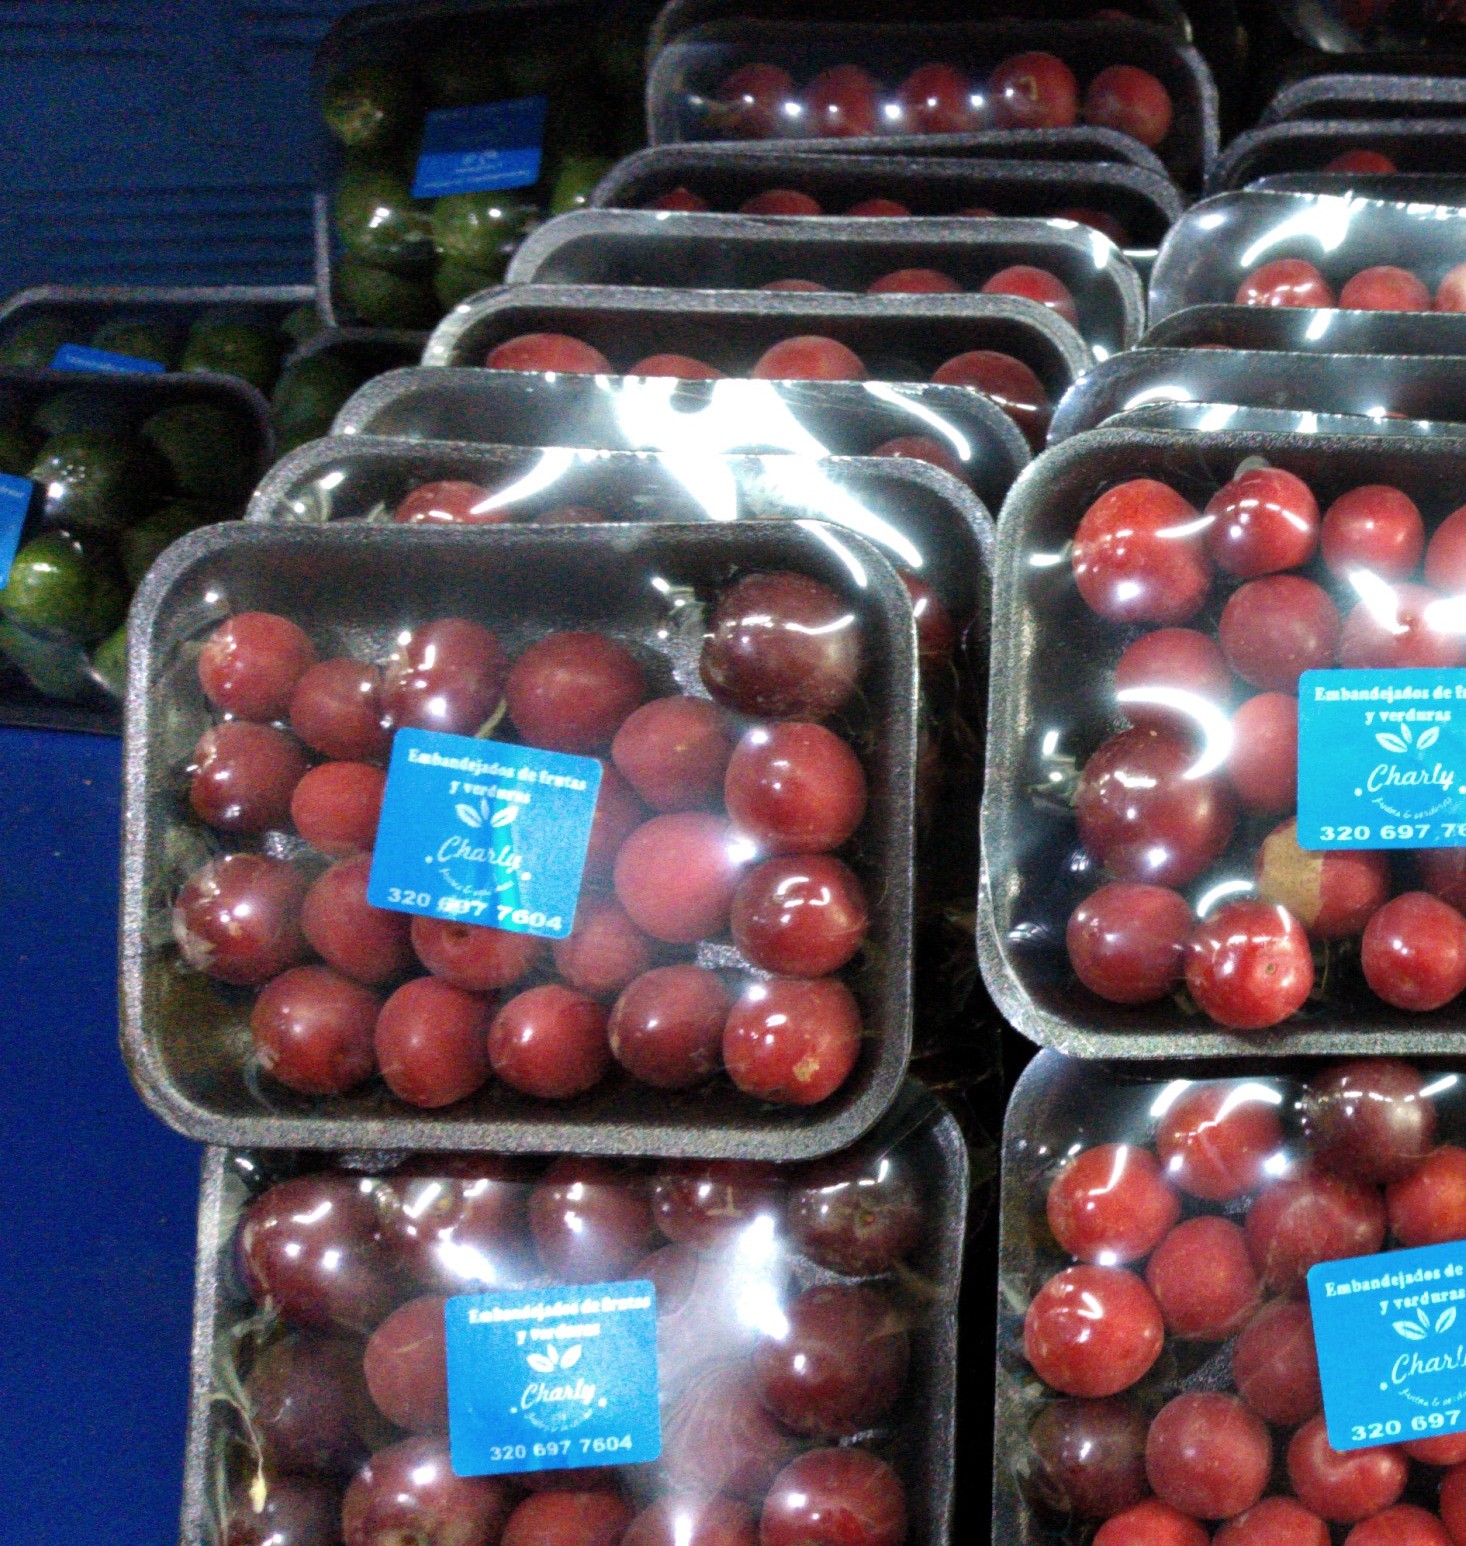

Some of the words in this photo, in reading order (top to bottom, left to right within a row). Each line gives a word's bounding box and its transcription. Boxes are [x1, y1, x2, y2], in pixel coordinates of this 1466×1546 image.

[1315, 686, 1429, 703] Embandejados
[1433, 685, 1452, 700] de
[1365, 711, 1376, 725] y
[1379, 708, 1451, 723] verduras
[408, 748, 515, 778] Embandejados
[517, 767, 537, 782] de
[539, 771, 586, 790] frutas
[1367, 763, 1454, 792] Charly
[449, 780, 461, 794] y
[1320, 826, 1371, 841] 320
[1380, 824, 1430, 839] 697
[437, 836, 523, 874] Charly
[387, 887, 431, 907] 320
[497, 905, 562, 931] 7604
[1325, 1268, 1441, 1297] Embandejados
[1444, 1263, 1464, 1278] de
[1380, 1300, 1389, 1316] y
[1393, 1288, 1466, 1310] verduras
[520, 1378, 596, 1410] Charly
[1351, 1420, 1401, 1441] 320
[1411, 1410, 1461, 1431] 697
[490, 1445, 526, 1461] 320
[533, 1440, 571, 1457] 697
[579, 1434, 633, 1454] 7604
